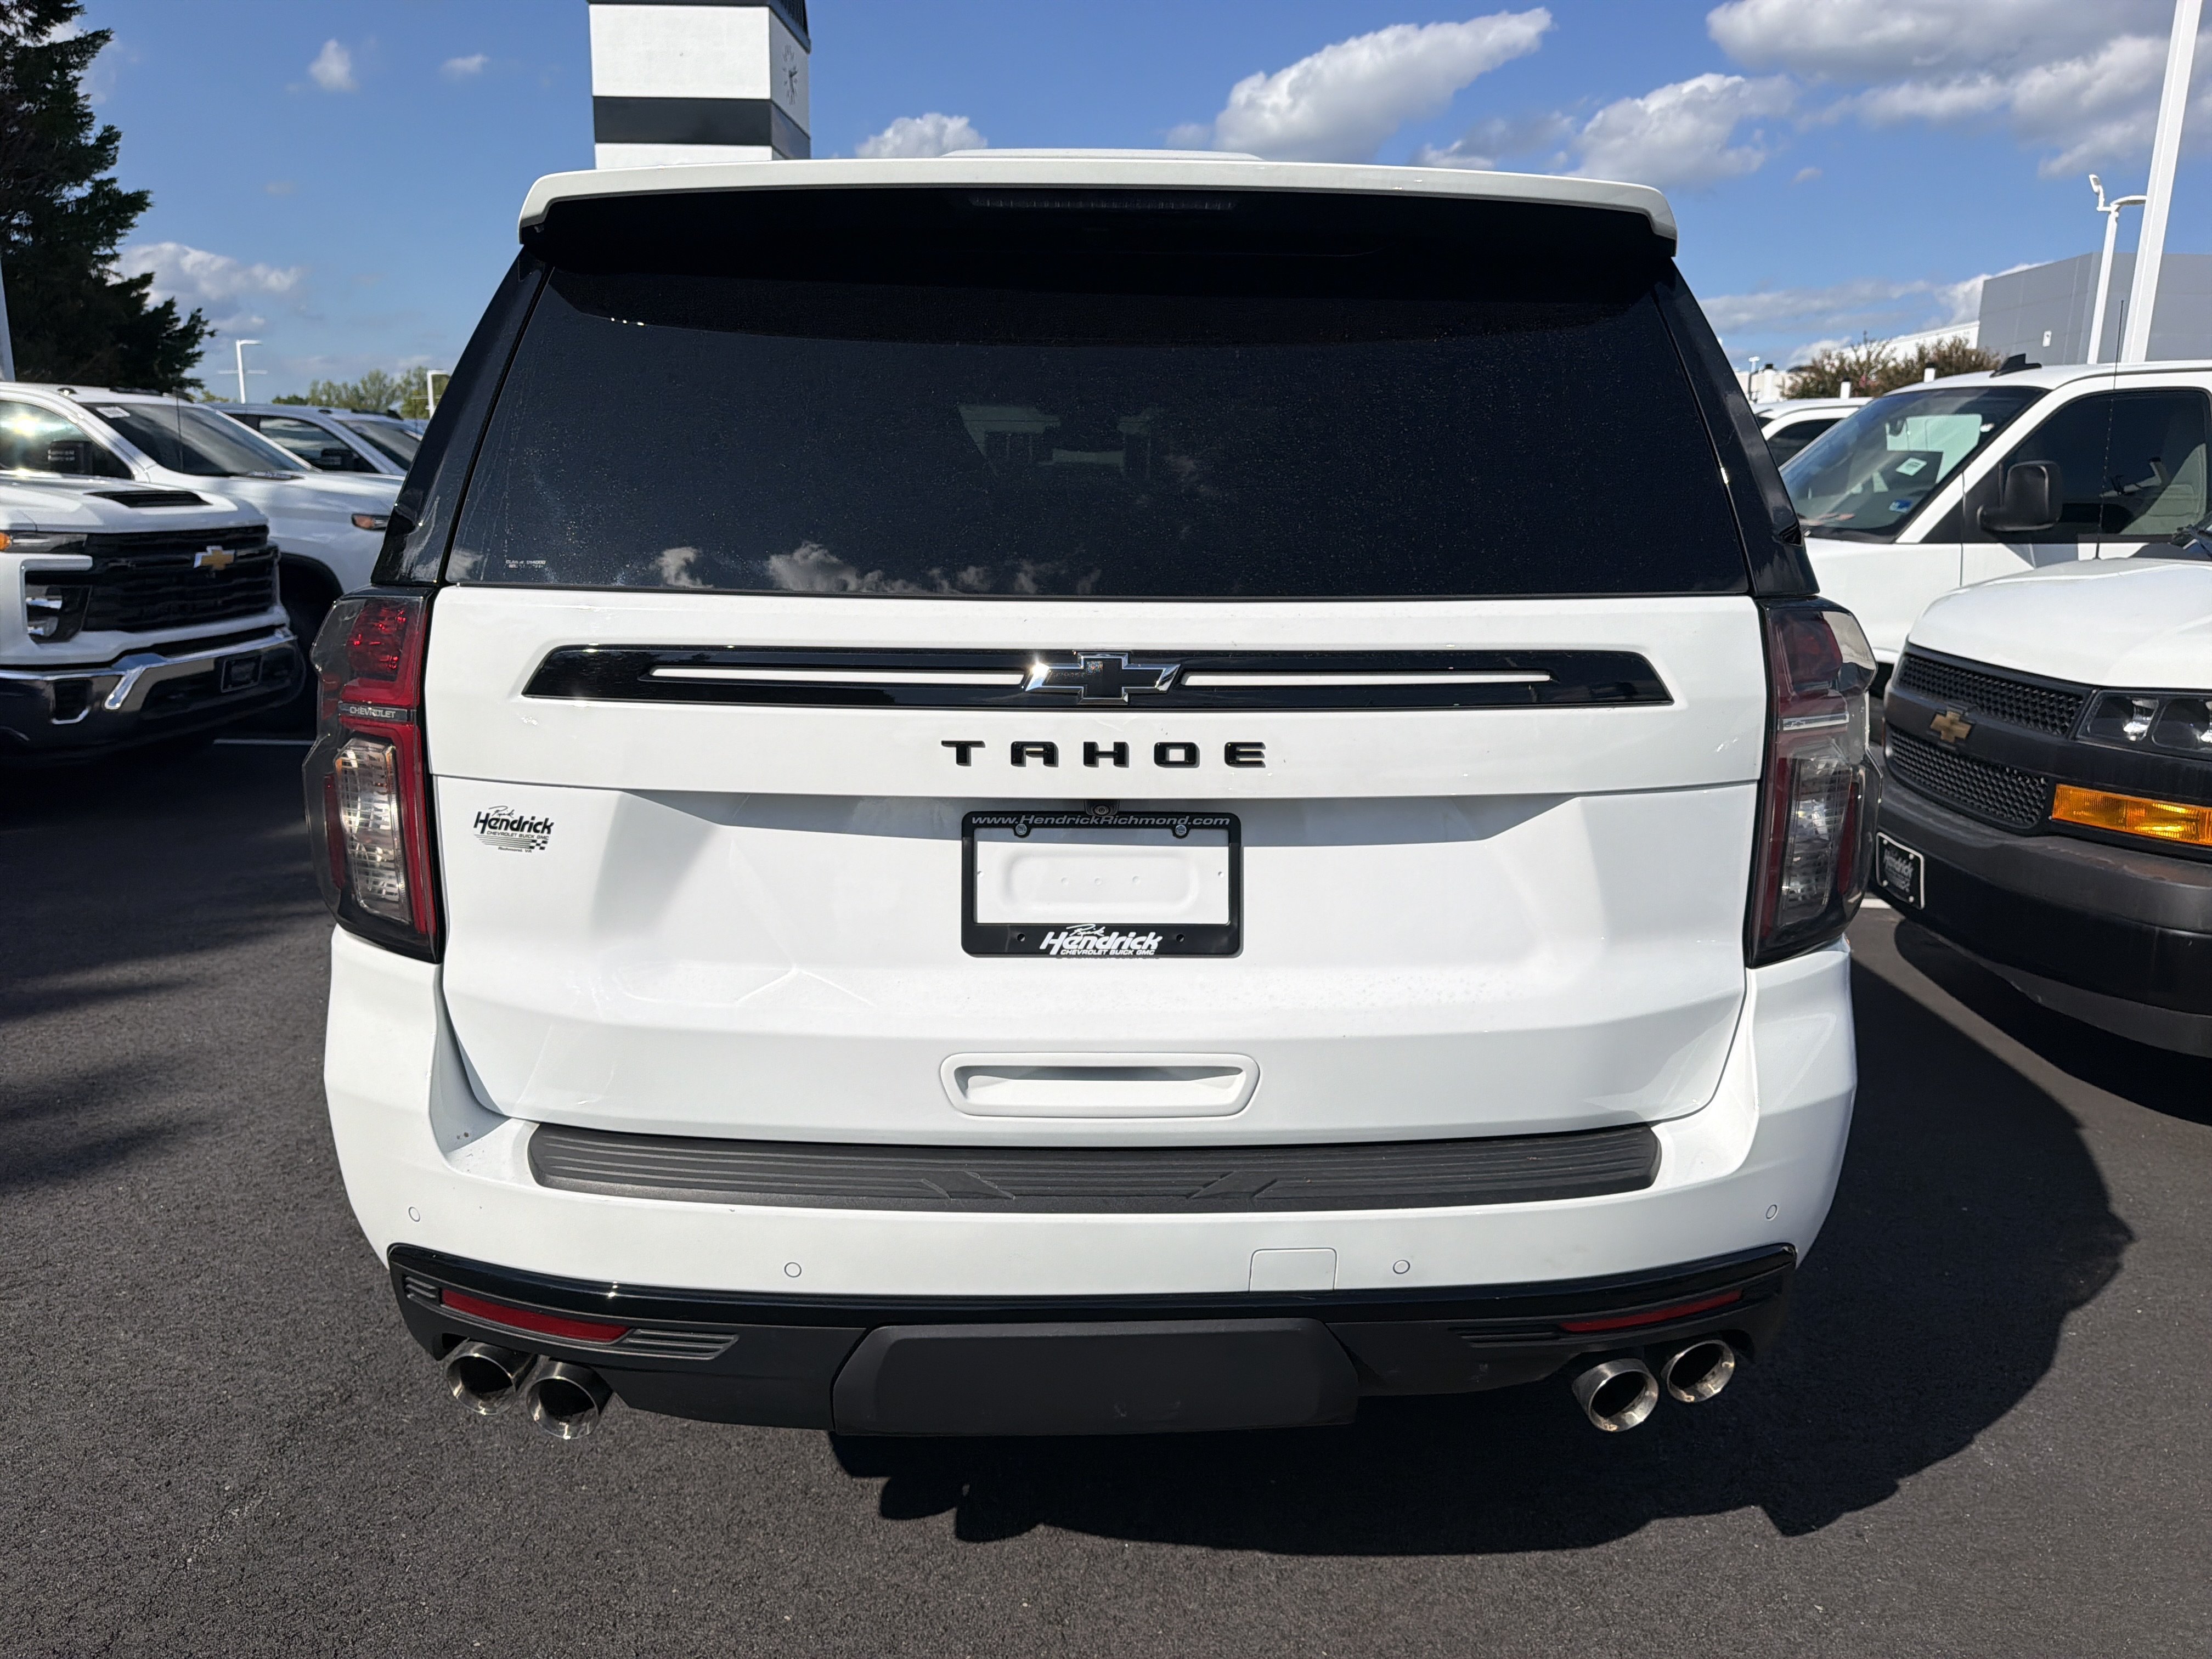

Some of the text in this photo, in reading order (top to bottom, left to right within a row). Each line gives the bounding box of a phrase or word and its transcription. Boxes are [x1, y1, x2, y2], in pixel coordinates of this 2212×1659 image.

[349, 706, 396, 718] CHEVROLET
[941, 740, 1266, 767] TAHOE
[473, 811, 554, 834] Hendrick
[972, 815, 1230, 826] www.HendrickRichmond.com
[1039, 932, 1163, 955] Hendrick
